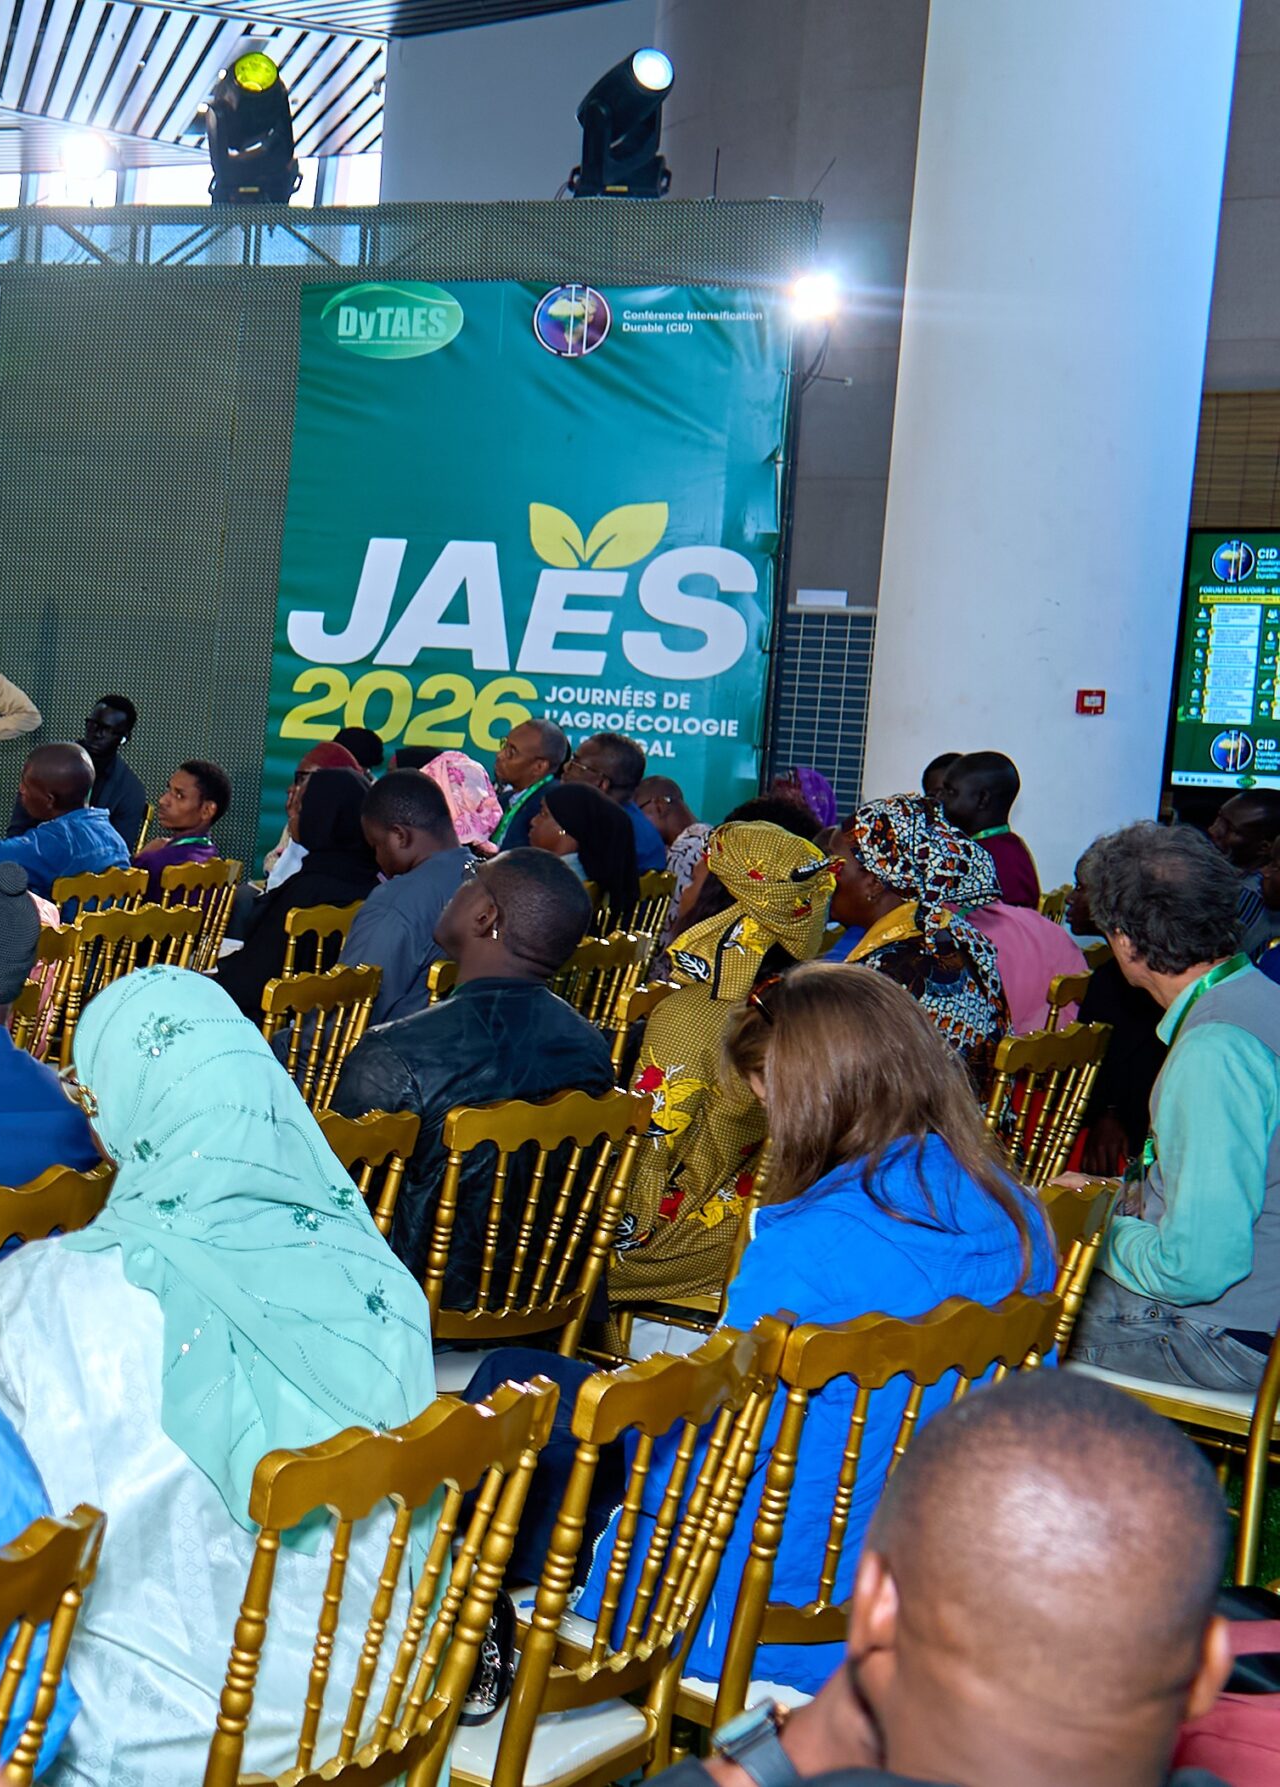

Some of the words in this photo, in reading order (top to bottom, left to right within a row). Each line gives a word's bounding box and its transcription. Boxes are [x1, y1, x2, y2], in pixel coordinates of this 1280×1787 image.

[338, 305, 448, 340] DyTAES
[622, 310, 684, 321] Conférence
[686, 310, 763, 321] Intensification
[622, 323, 663, 333] Durable
[666, 323, 693, 334] (CID)
[1257, 548, 1278, 560] CID
[287, 536, 759, 680] JAES
[544, 685, 657, 709] JOURNÉES
[662, 692, 691, 710] DE
[279, 667, 538, 752] 2026
[1256, 738, 1277, 751] CID
